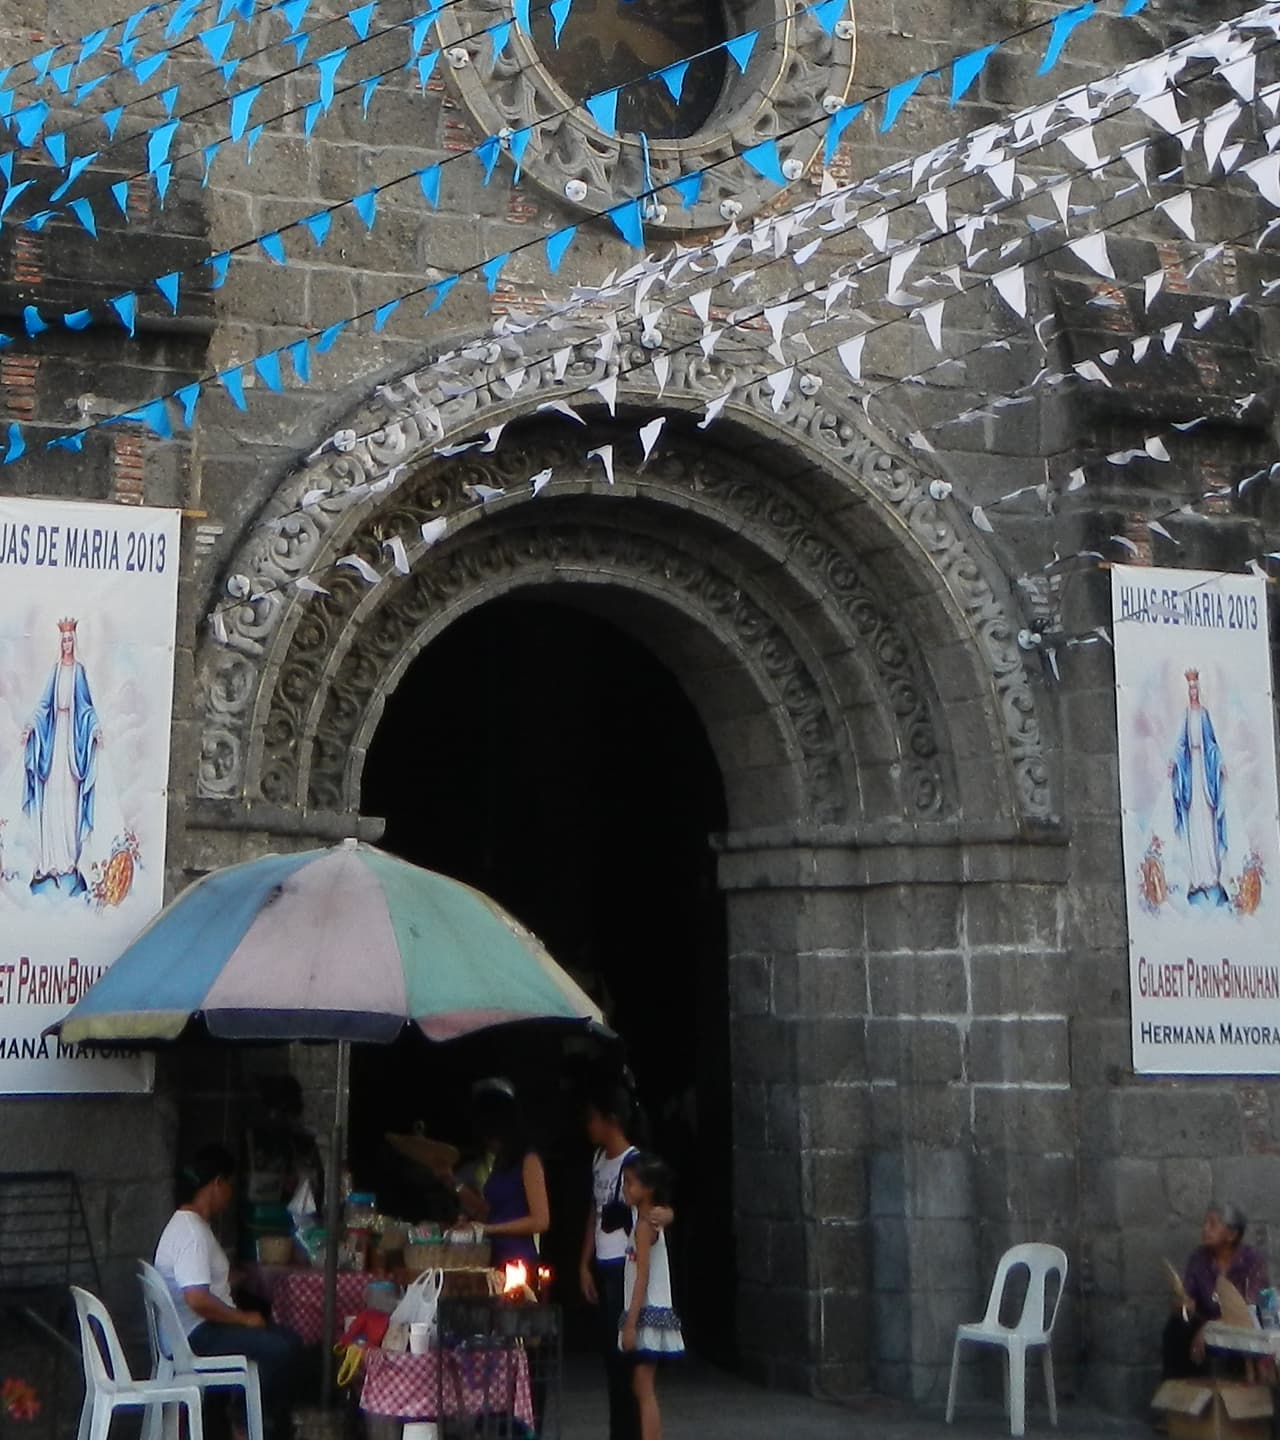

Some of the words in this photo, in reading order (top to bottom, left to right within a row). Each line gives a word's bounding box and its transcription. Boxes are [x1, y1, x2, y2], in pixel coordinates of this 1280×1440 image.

[36, 525, 59, 567] DE
[64, 527, 119, 570] MARIA
[125, 531, 166, 573] 2013
[1120, 586, 1158, 624] HIJAS
[1161, 589, 1180, 626] DE
[1184, 591, 1225, 628] MARIA
[1228, 594, 1258, 630] 2013
[1138, 956, 1184, 998] GILABET
[1186, 957, 1280, 999] PARIN-BINAUHAN
[1140, 1021, 1216, 1045] HERMANA
